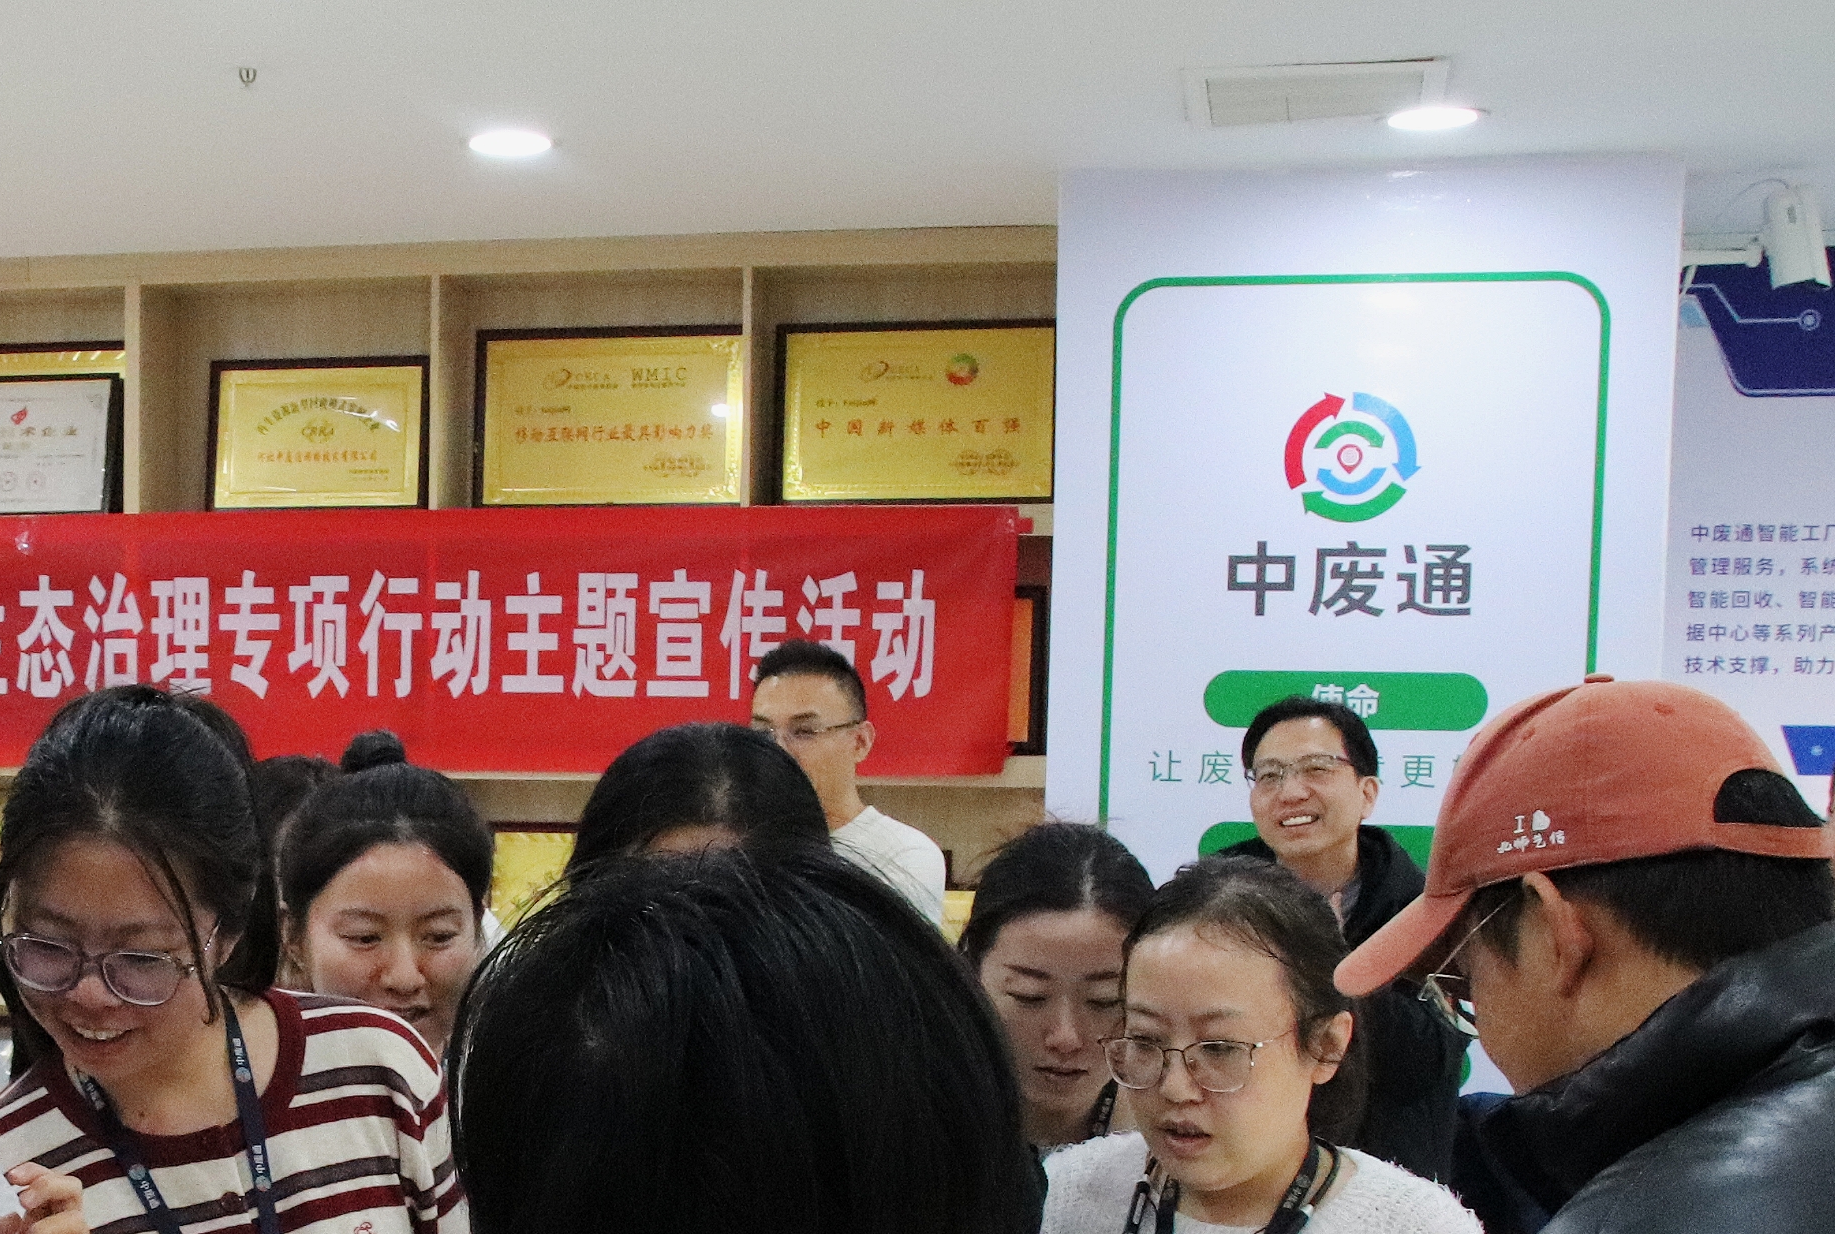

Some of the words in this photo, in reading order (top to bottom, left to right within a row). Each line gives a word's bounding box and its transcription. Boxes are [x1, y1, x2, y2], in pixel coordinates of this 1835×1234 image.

[631, 367, 687, 383] WMIC
[815, 417, 1021, 439] 中国新媒体百强
[1226, 541, 1473, 619] 中废通
